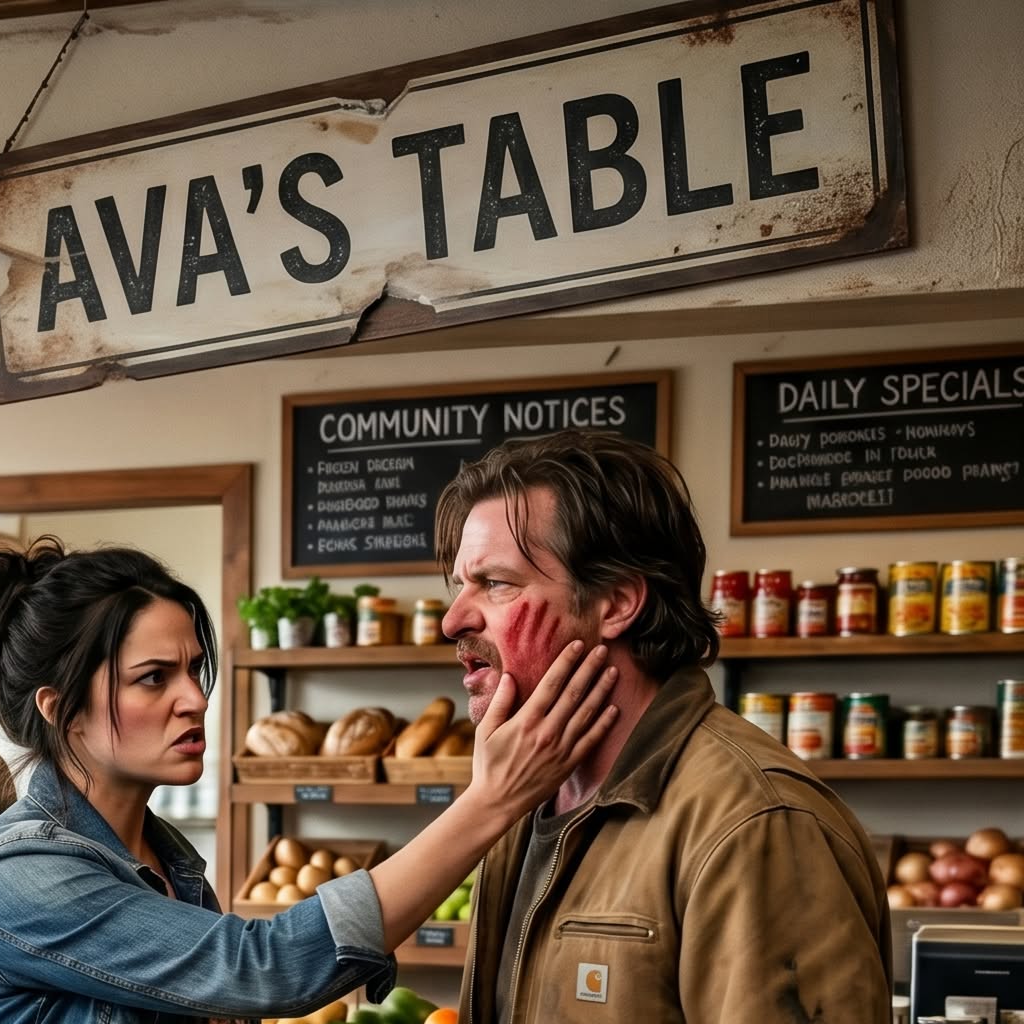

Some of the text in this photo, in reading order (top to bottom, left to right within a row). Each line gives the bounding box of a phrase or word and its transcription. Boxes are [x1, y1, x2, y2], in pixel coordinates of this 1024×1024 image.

[37, 51, 820, 333] AVA'S TABLE
[779, 366, 1024, 413] DAILY SPECIALS
[320, 396, 626, 443] COMMUNITY NOTICES
